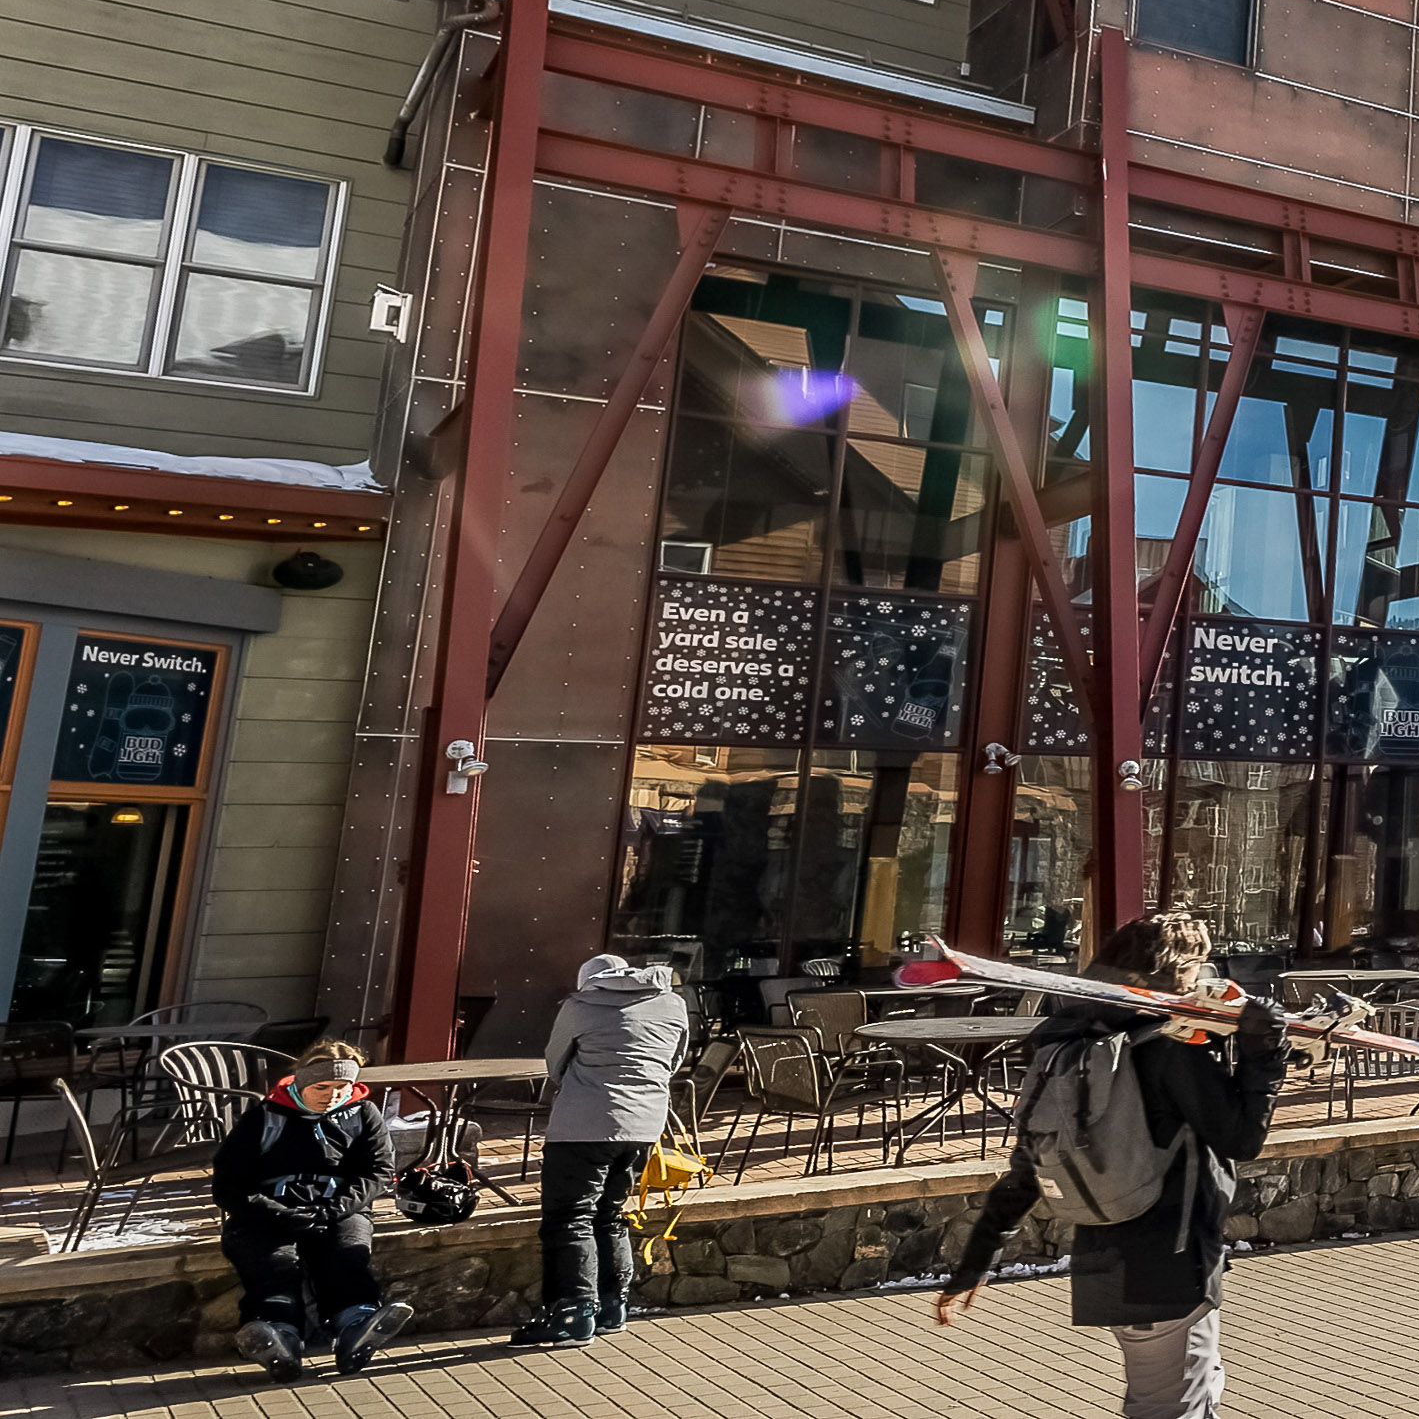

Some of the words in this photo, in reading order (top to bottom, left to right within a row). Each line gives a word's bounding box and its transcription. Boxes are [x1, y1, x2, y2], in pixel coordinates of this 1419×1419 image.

[662, 602, 726, 623] Even
[732, 610, 749, 624] a
[659, 631, 720, 649] yard
[725, 633, 778, 651] sale
[1193, 627, 1279, 654] Never
[82, 645, 140, 666] Never
[141, 652, 207, 674] Switch.
[655, 654, 772, 676] deserves
[778, 664, 794, 677] a
[1190, 662, 1290, 687] switch.
[652, 681, 709, 699] cold
[714, 686, 770, 702] one.
[904, 702, 936, 719] BUD
[125, 736, 163, 750] BUD
